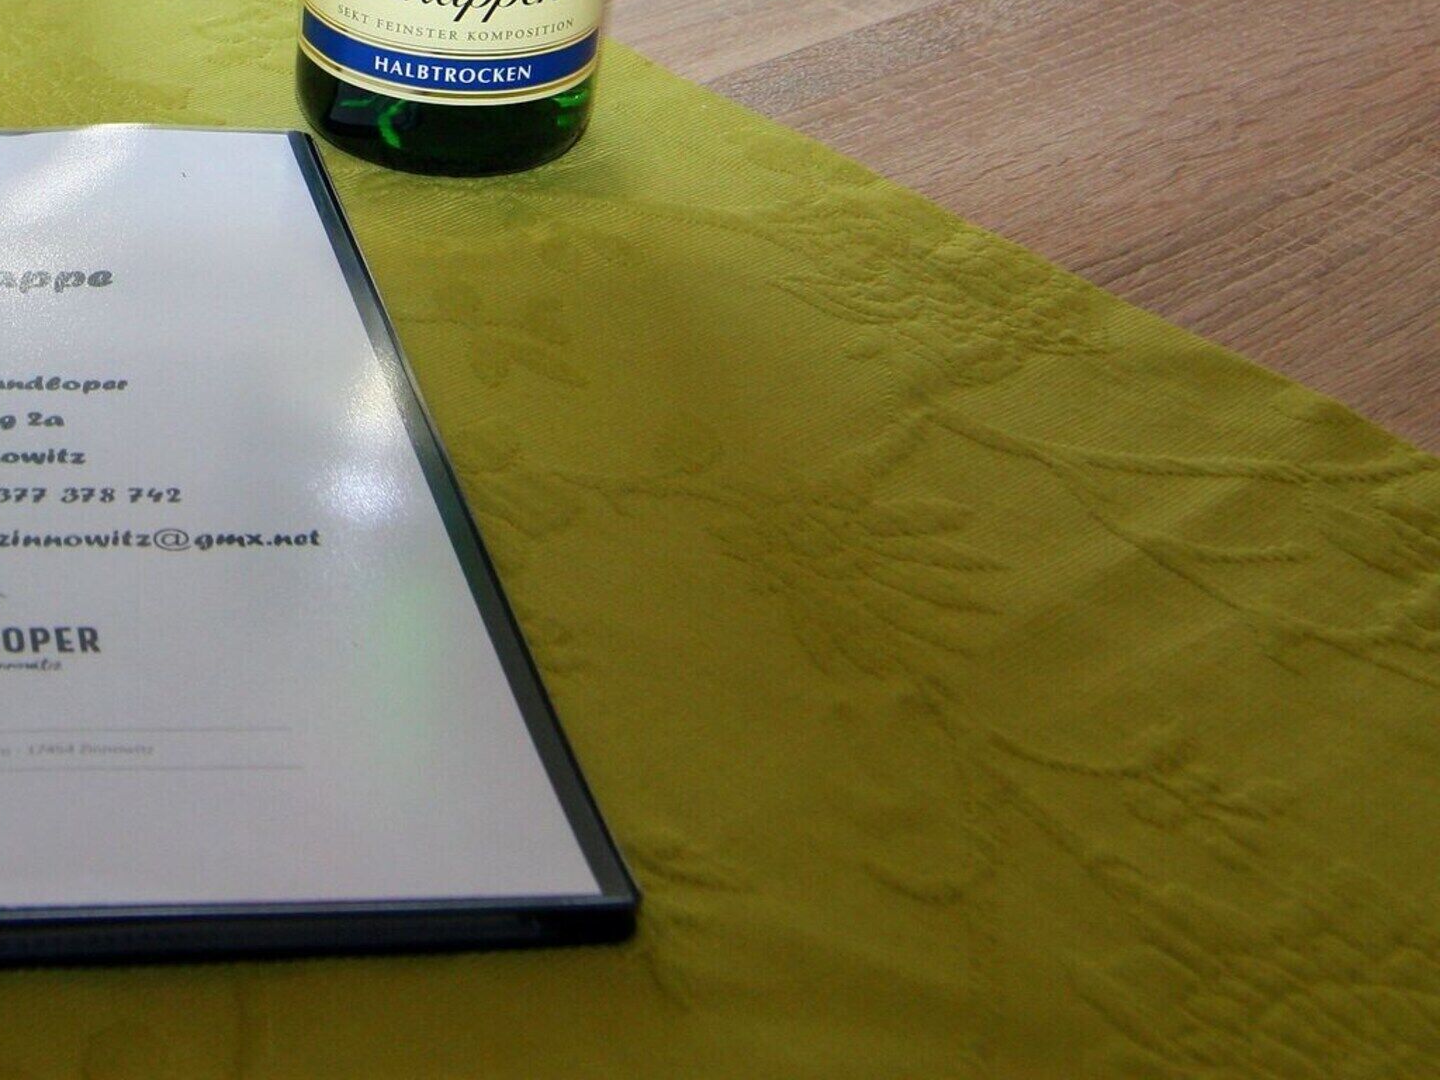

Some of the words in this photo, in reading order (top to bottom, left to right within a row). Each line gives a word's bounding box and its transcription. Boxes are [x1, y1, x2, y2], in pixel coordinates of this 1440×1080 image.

[337, 4, 369, 25] SEKT
[376, 18, 459, 42] FEINSTER
[466, 18, 575, 42] KOMPOSITION
[373, 55, 533, 85] HALBTROCKEN
[26, 411, 66, 428] 2a
[60, 487, 116, 504] 378
[127, 487, 184, 504] 742
